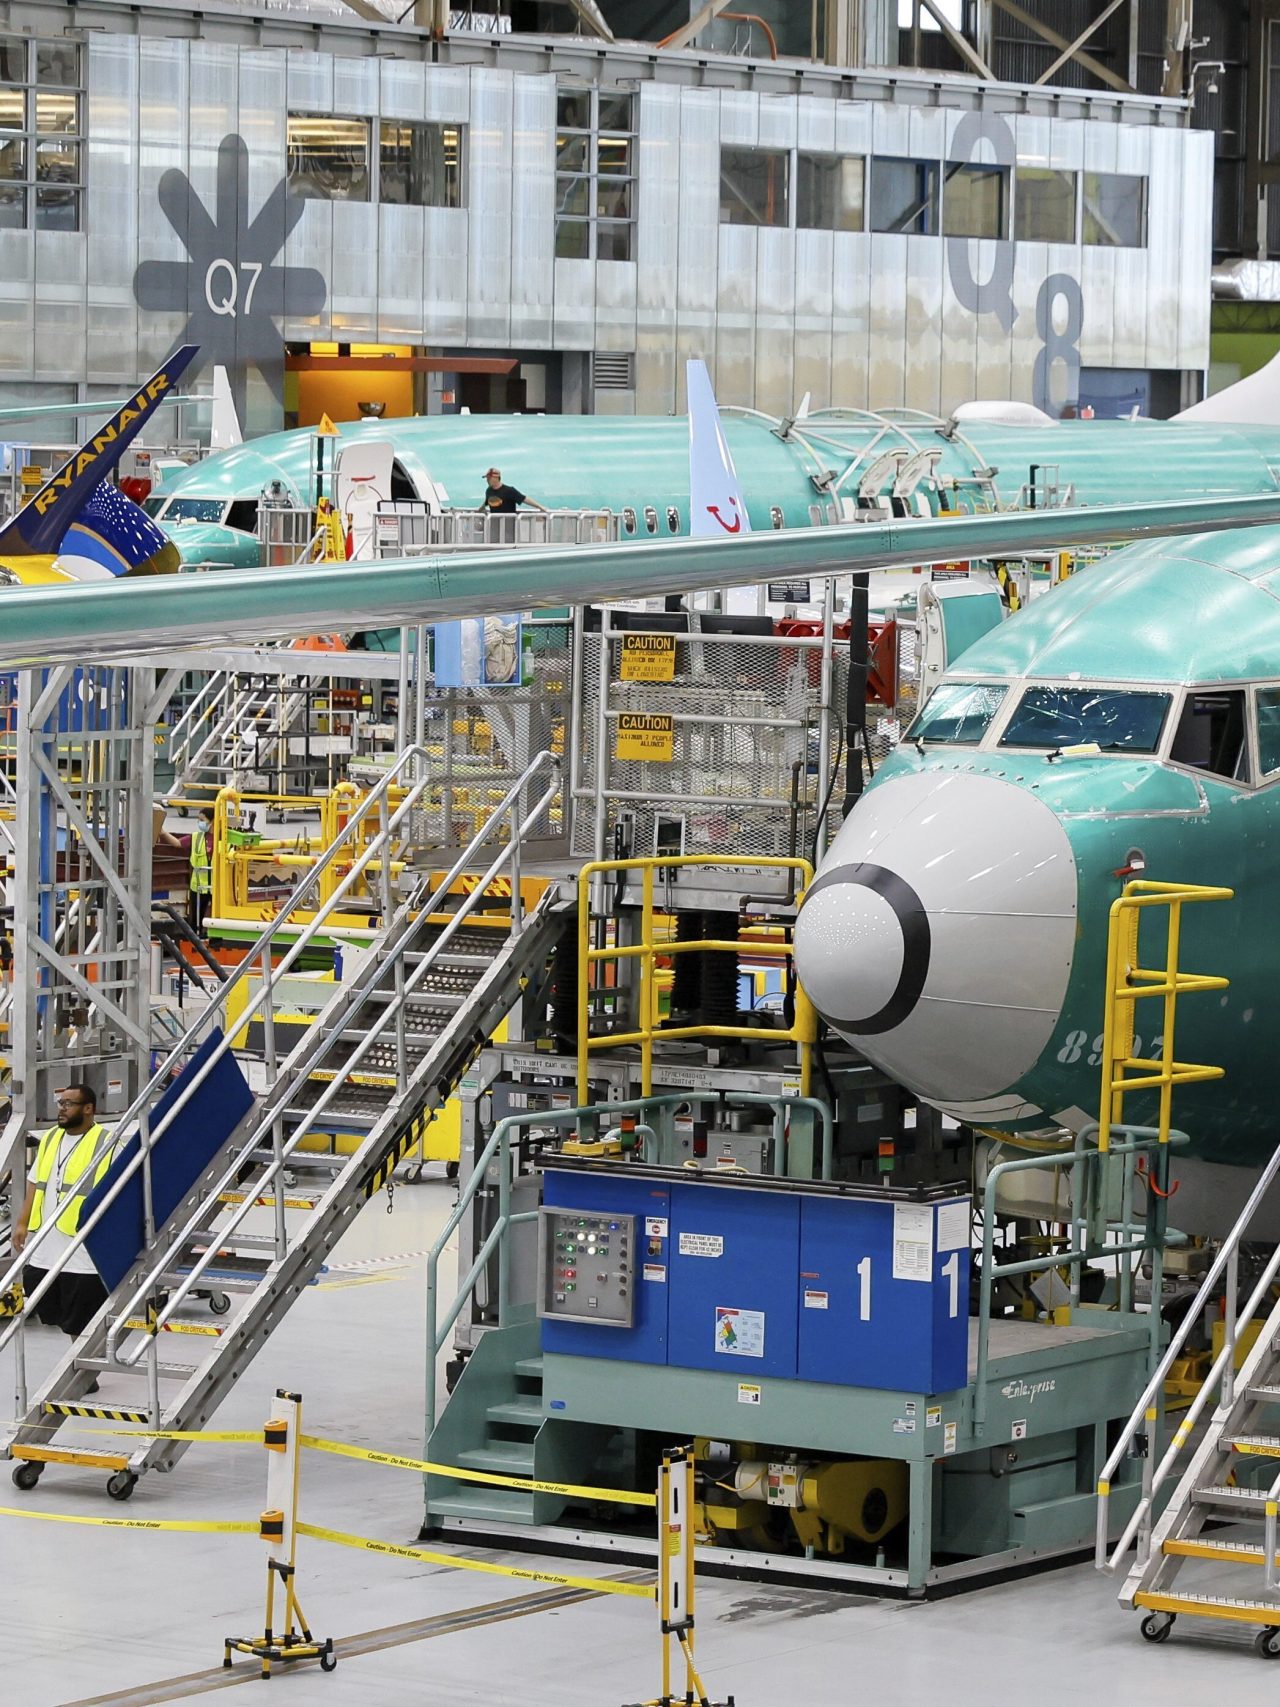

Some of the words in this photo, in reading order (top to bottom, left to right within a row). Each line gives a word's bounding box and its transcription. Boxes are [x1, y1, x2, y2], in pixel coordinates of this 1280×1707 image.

[205, 260, 262, 317] Q7
[34, 373, 169, 515] RYANAIR
[627, 636, 671, 649] CAUTION
[622, 715, 669, 729] CAUTION
[857, 1257, 871, 1321] 1
[942, 1252, 958, 1318] 1
[368, 1453, 387, 1462] Caution
[409, 1461, 423, 1469] Enter
[366, 1541, 386, 1551] Caution
[407, 1550, 421, 1558] Enter
